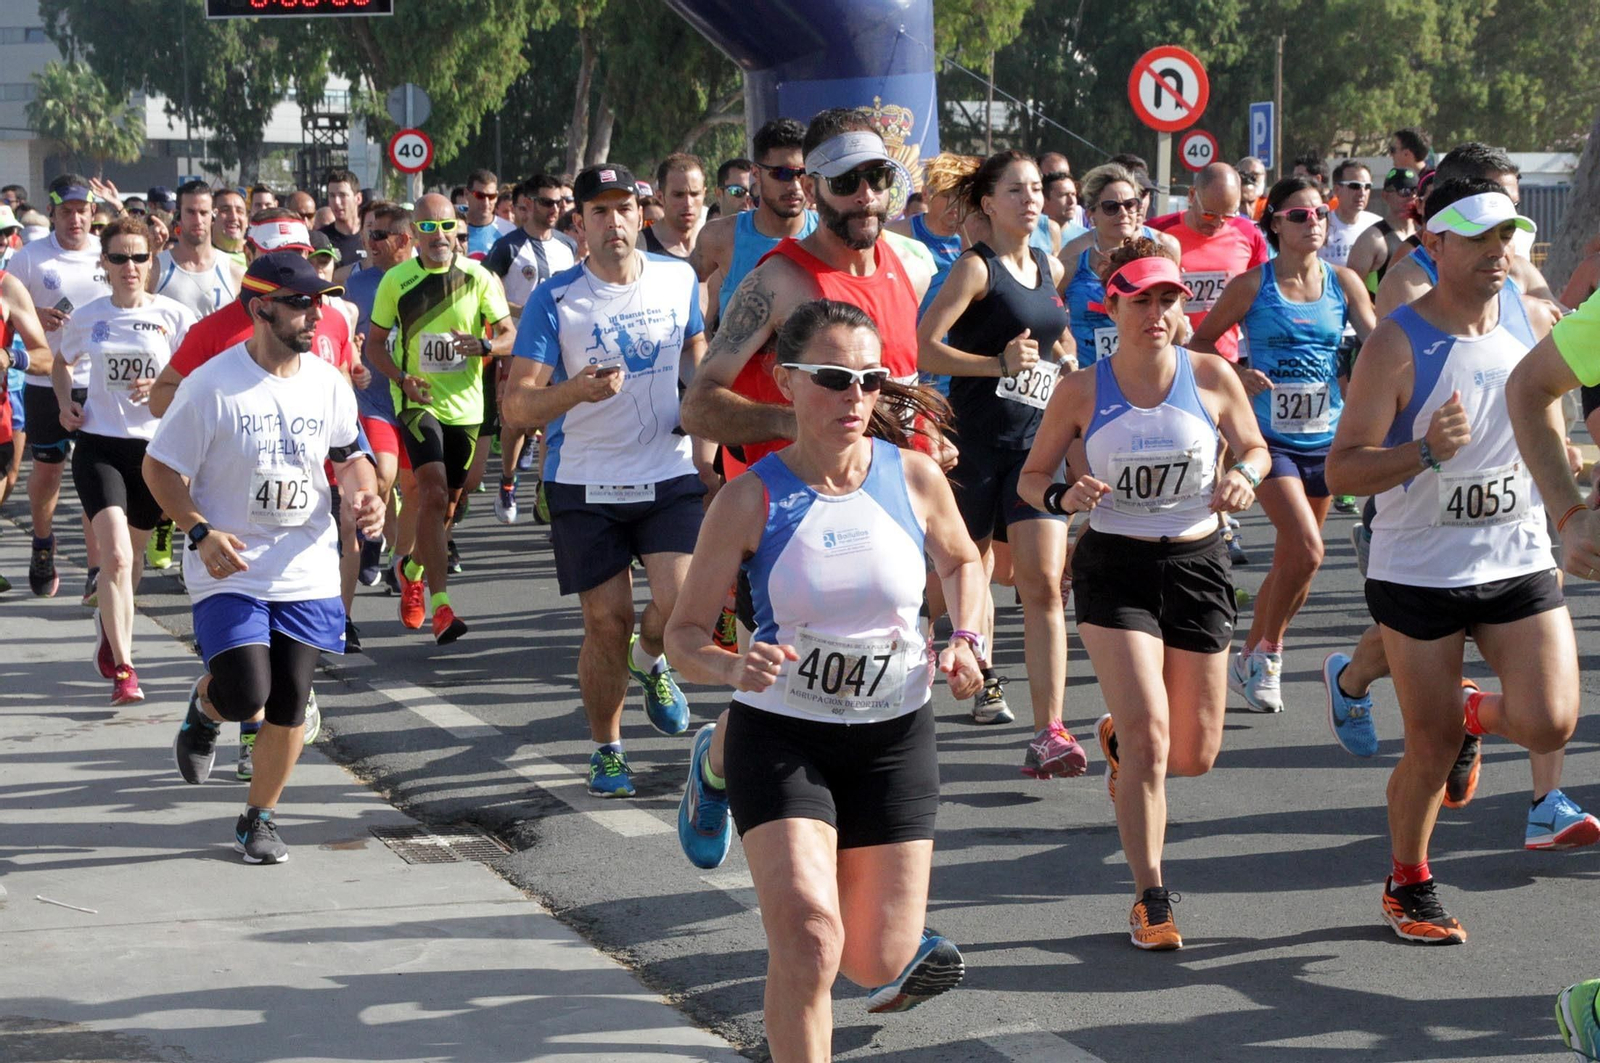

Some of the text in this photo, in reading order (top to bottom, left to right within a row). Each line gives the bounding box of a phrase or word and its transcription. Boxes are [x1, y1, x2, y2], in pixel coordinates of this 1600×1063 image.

[1252, 111, 1267, 158] P
[398, 143, 424, 158] 40
[1187, 143, 1210, 158] 40
[108, 358, 156, 381] 3296
[1277, 392, 1326, 420] 3217
[240, 414, 323, 437] RUTA 091
[258, 439, 306, 456] HUELVA
[1117, 461, 1190, 499] 4077
[255, 480, 308, 510] 4125
[1447, 476, 1516, 519] 4055
[798, 648, 891, 697] 4047
[845, 699, 890, 709] DEPORTIVA
